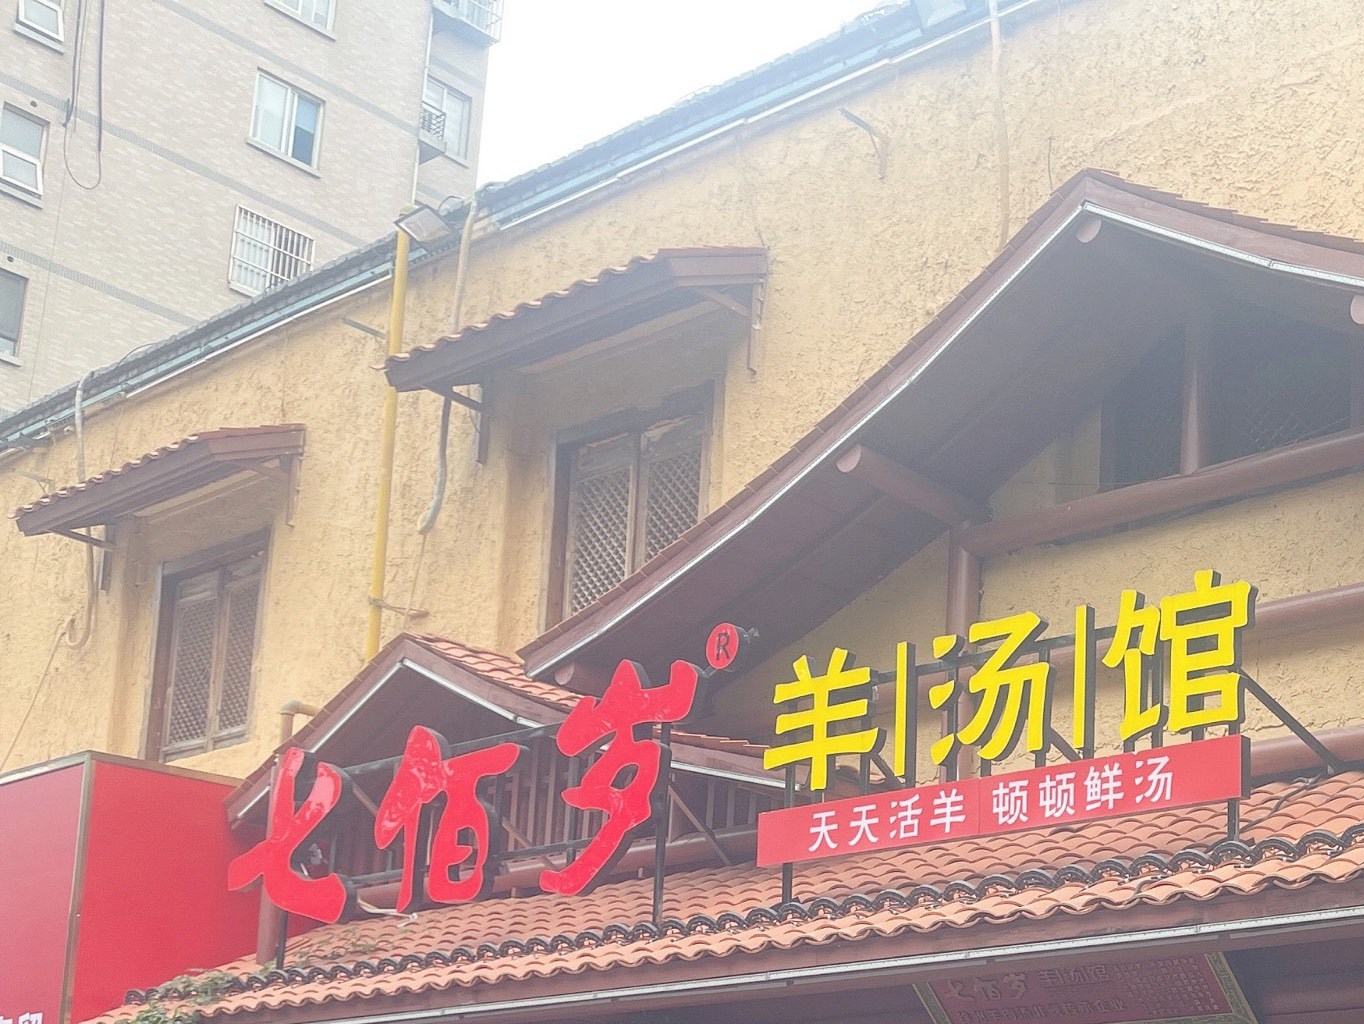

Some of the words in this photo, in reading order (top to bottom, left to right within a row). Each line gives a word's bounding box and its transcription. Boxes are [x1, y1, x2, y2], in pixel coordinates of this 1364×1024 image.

[228, 659, 698, 923] 七佰岁
[808, 790, 967, 852] 天天活羊
[992, 757, 1173, 824] 顿顿鲜汤
